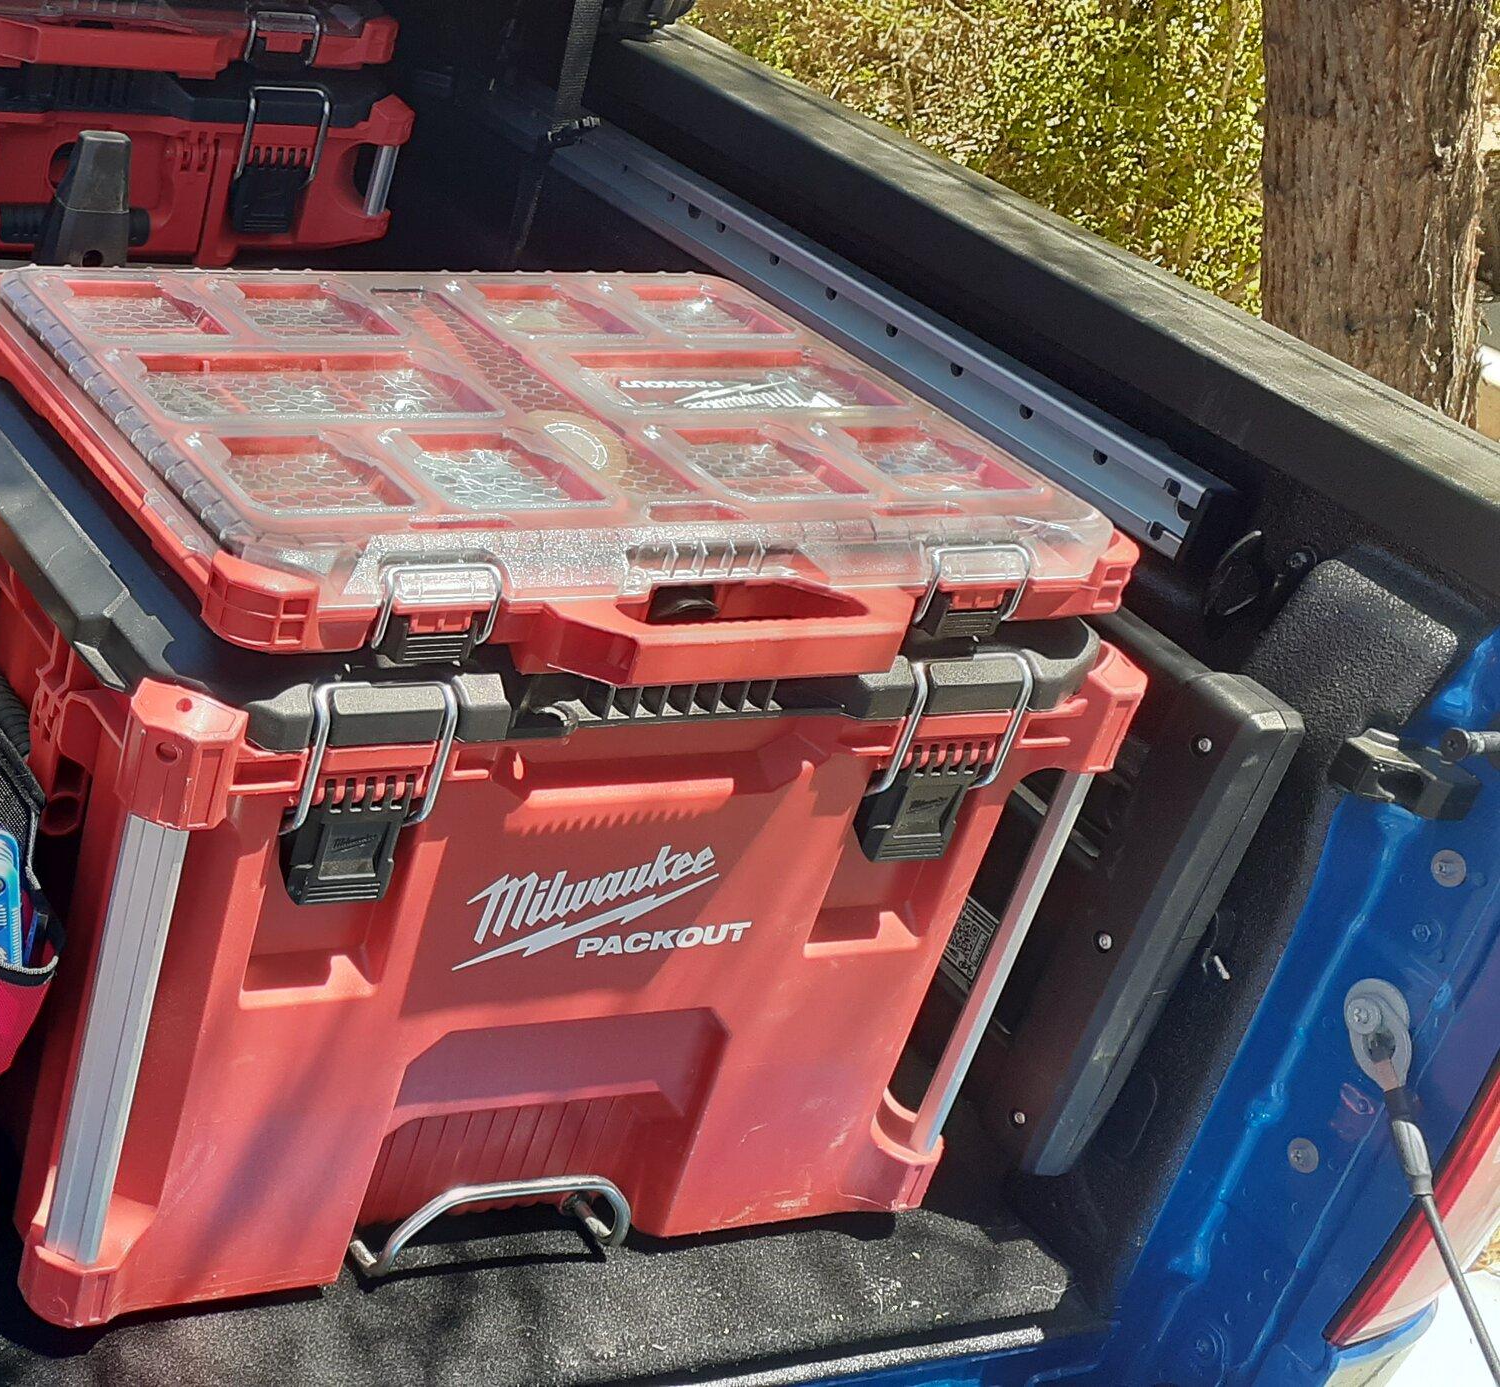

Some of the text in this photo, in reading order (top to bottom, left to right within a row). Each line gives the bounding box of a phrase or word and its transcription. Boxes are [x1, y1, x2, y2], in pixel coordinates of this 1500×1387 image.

[620, 380, 724, 389] PACKOUT
[683, 386, 842, 410] Milwaukee
[467, 845, 716, 944] Milwaukee
[576, 921, 752, 958] PACKOUT
